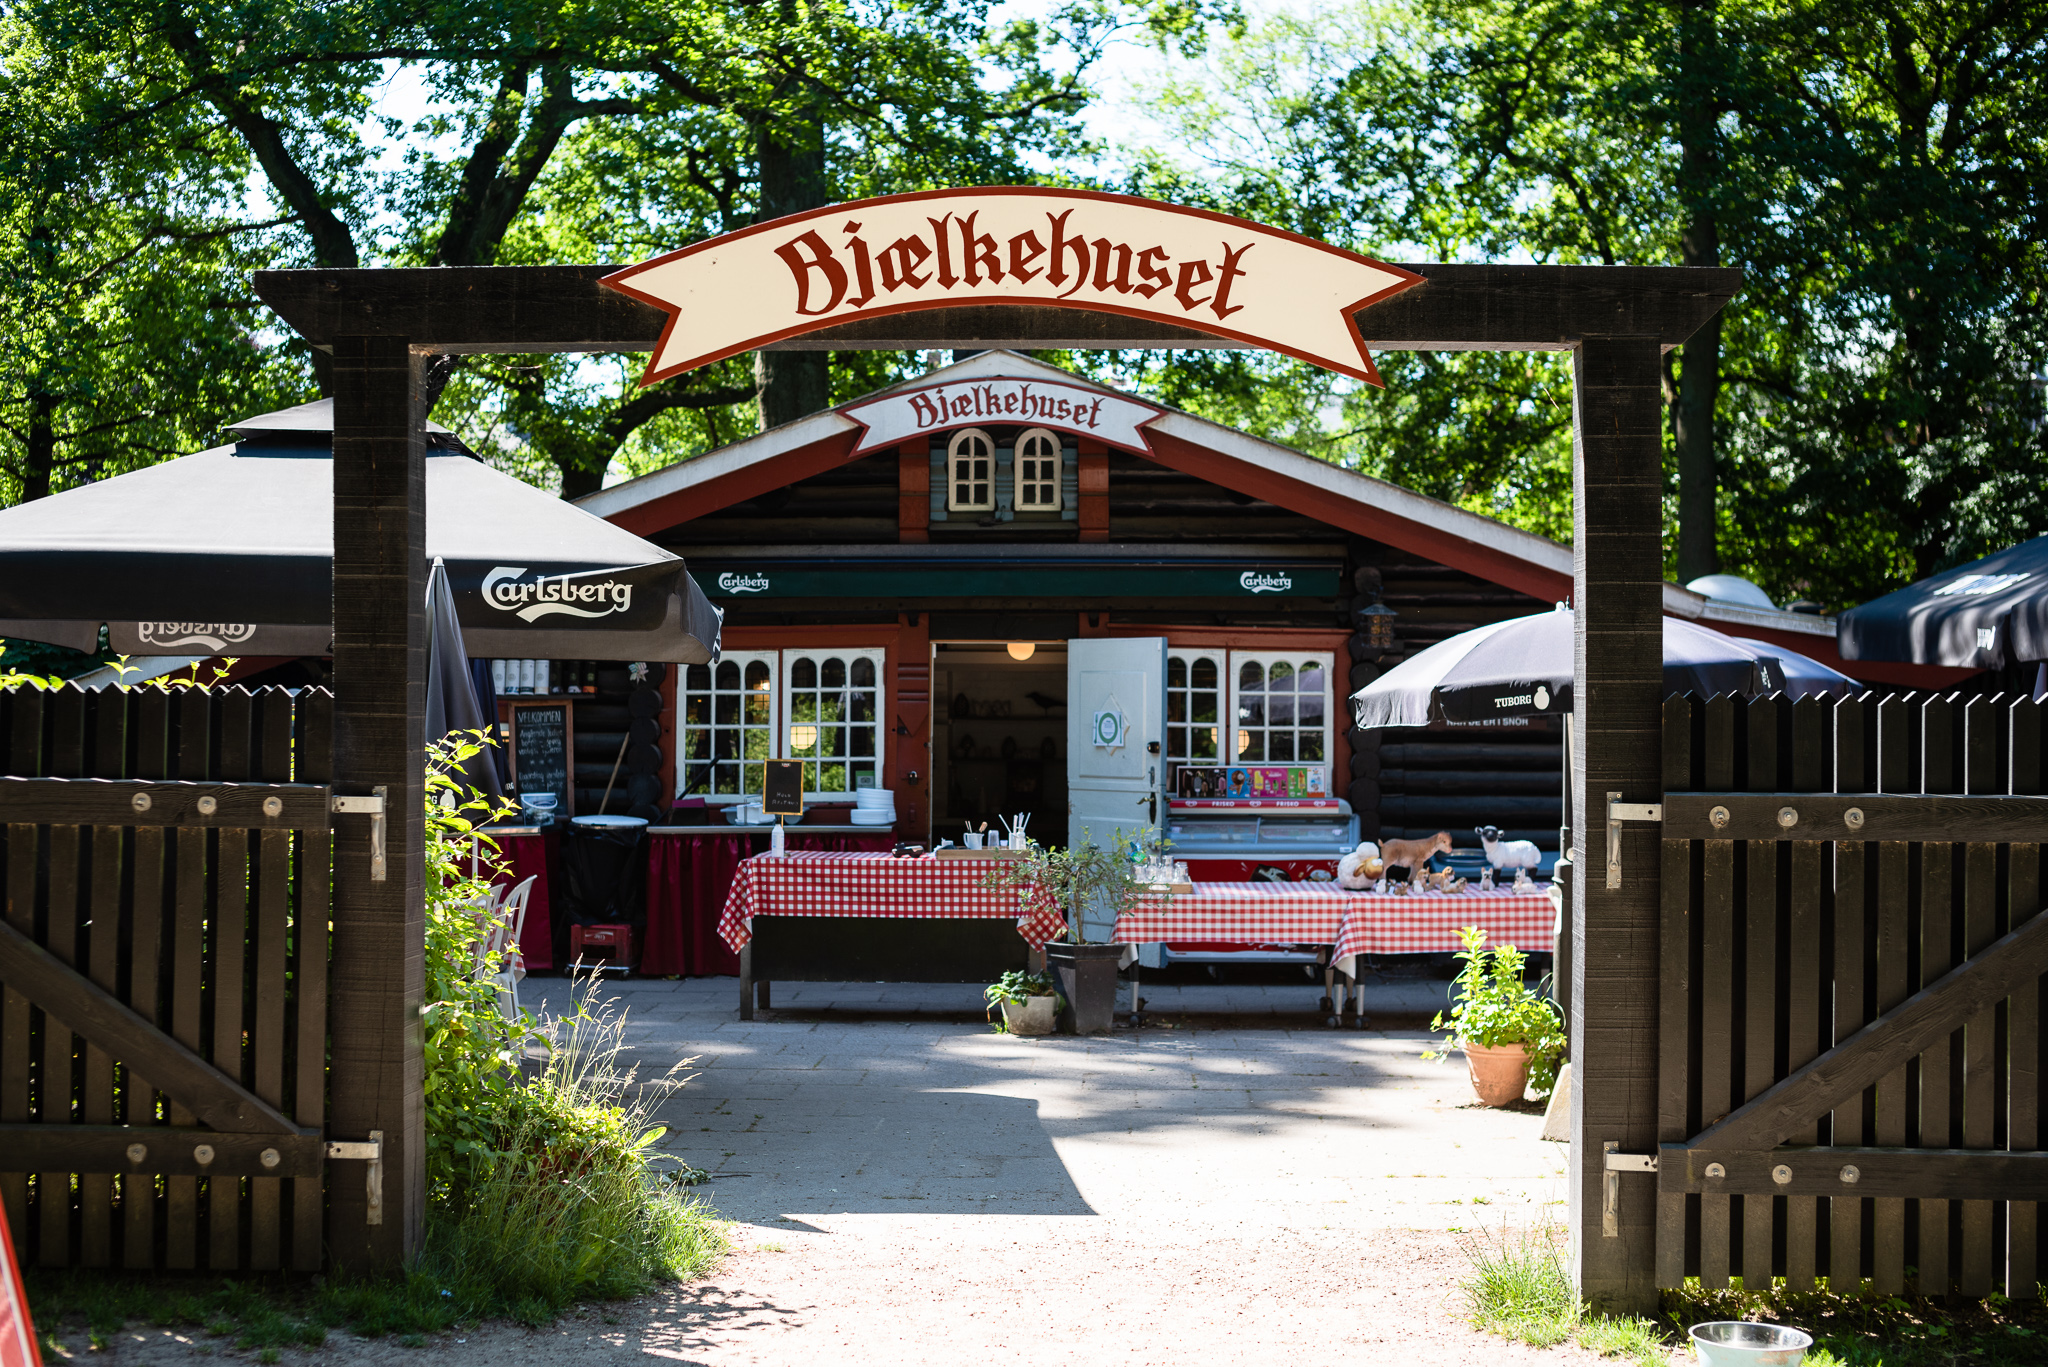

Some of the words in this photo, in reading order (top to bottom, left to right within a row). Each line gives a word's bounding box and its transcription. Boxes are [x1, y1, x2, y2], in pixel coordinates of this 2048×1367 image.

[774, 208, 1256, 321] Bjælkehuset
[907, 383, 1106, 429] Bjælkehuset
[481, 566, 633, 620] Carlsberg
[718, 572, 769, 593] Carlsberg
[1240, 571, 1292, 593] Carlsberg
[1494, 694, 1532, 708] TUBORG
[518, 711, 561, 723] VELKOMMEN
